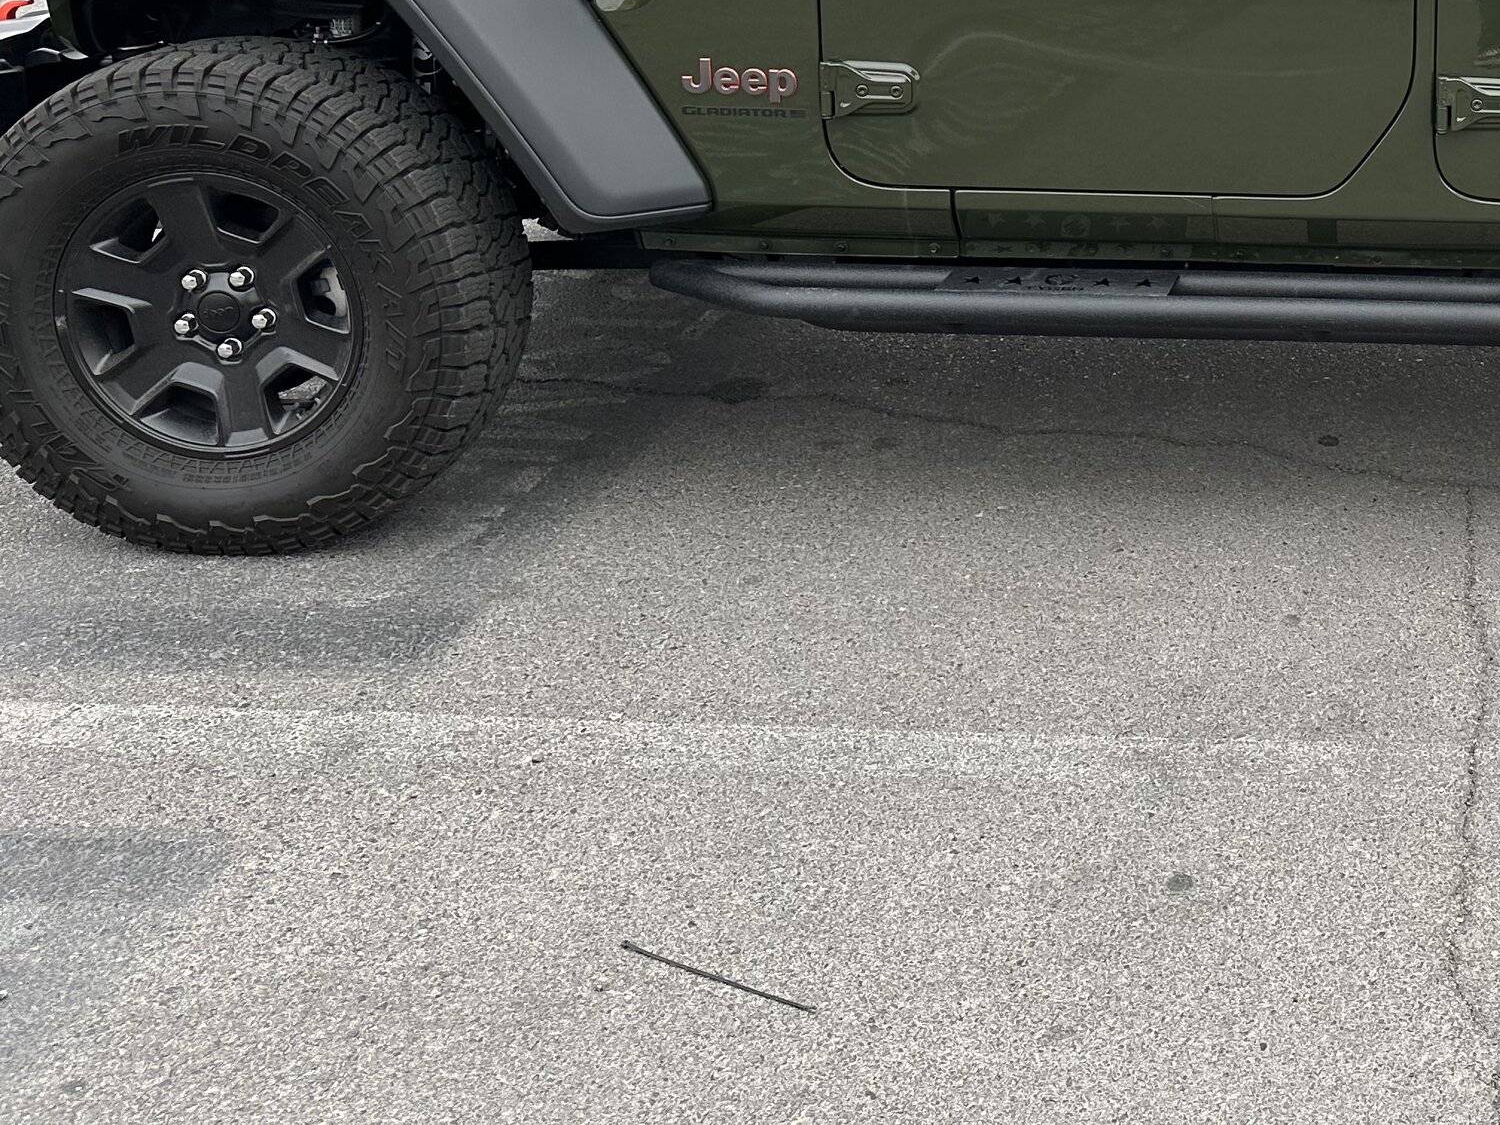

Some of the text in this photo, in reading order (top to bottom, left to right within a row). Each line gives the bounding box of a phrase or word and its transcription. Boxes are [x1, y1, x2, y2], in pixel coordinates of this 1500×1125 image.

[682, 58, 798, 104] Jeep
[682, 106, 786, 118] GLADIATOR
[117, 124, 393, 275] WILDPEAK
